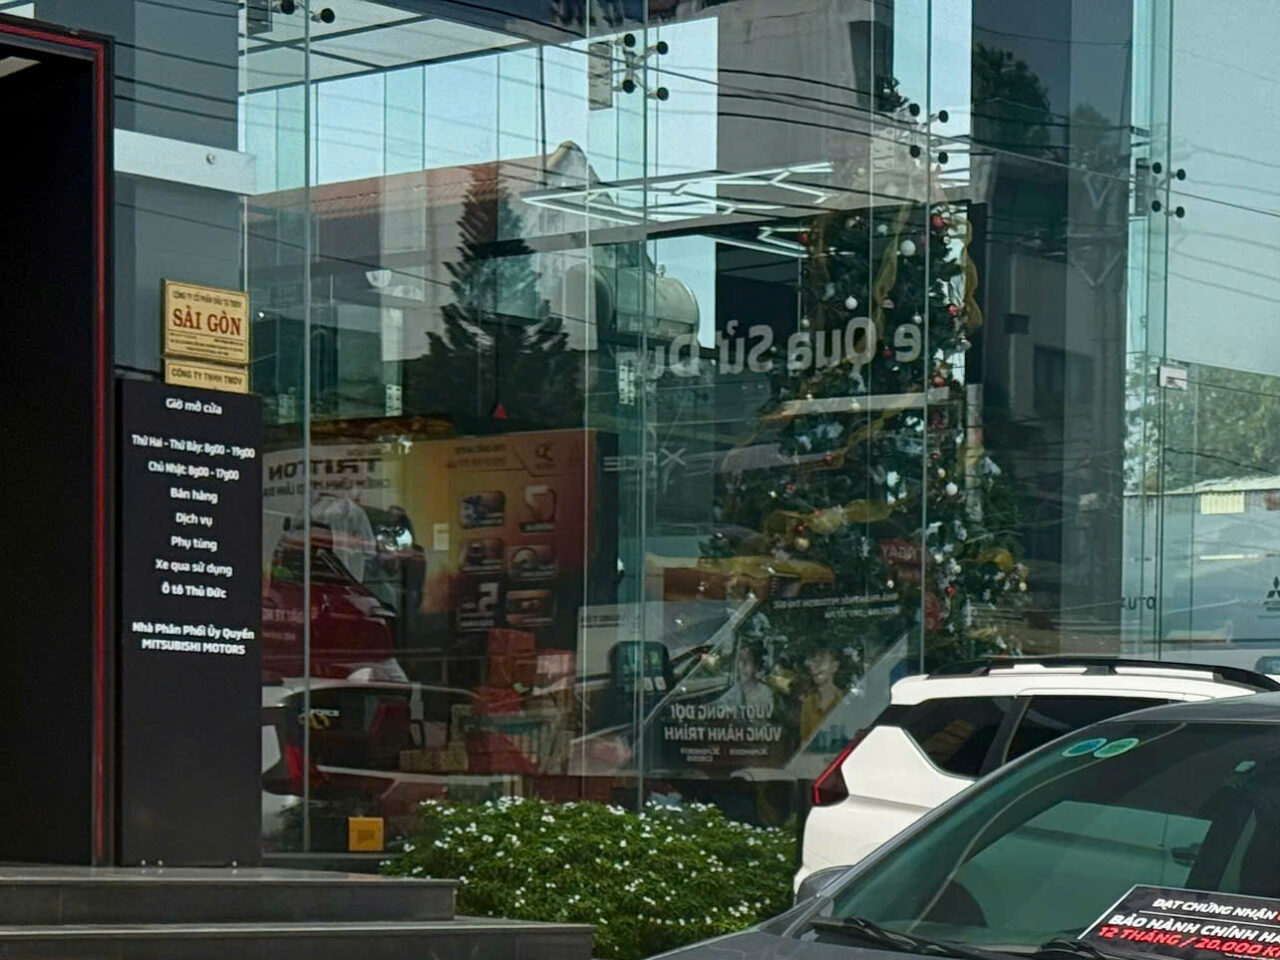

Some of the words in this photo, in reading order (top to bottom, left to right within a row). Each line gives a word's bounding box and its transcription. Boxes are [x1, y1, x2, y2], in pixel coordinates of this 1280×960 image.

[173, 305, 202, 330] SÀI
[207, 310, 242, 336] GÒN
[165, 398, 183, 410] Giờ
[185, 400, 202, 413] mở
[203, 402, 222, 415] cửa
[131, 434, 148, 446] Thứ
[149, 436, 163, 448] Hai
[169, 438, 185, 451] Thứ
[148, 460, 164, 472] Chủ
[170, 487, 190, 499] Bán
[192, 489, 218, 504] hàng
[175, 512, 198, 525] Dịch
[200, 517, 213, 528] vụ
[171, 536, 191, 550] Phụ
[193, 538, 218, 552] tùng
[155, 559, 169, 570] Xe
[171, 561, 190, 573] qua
[192, 561, 205, 573] sử
[206, 565, 233, 577] dụng
[185, 585, 205, 597] Thủ
[206, 586, 227, 599] Đức
[132, 621, 153, 633] Nhà
[155, 623, 181, 635] Phân
[183, 624, 206, 636] Phối
[222, 627, 255, 641] Quyền
[142, 639, 201, 652] MITSUBISHI
[203, 642, 246, 655] MOTORS
[1152, 898, 1184, 910] ĐẠT
[1182, 900, 1234, 917] CHỨNG
[1232, 905, 1277, 922] NHẬN
[1108, 913, 1146, 928] BẢO
[1148, 916, 1201, 936] HÀNH
[1200, 921, 1260, 942] CHÍNH
[1121, 928, 1180, 946] THÁNG
[1194, 937, 1262, 955] 20.000
